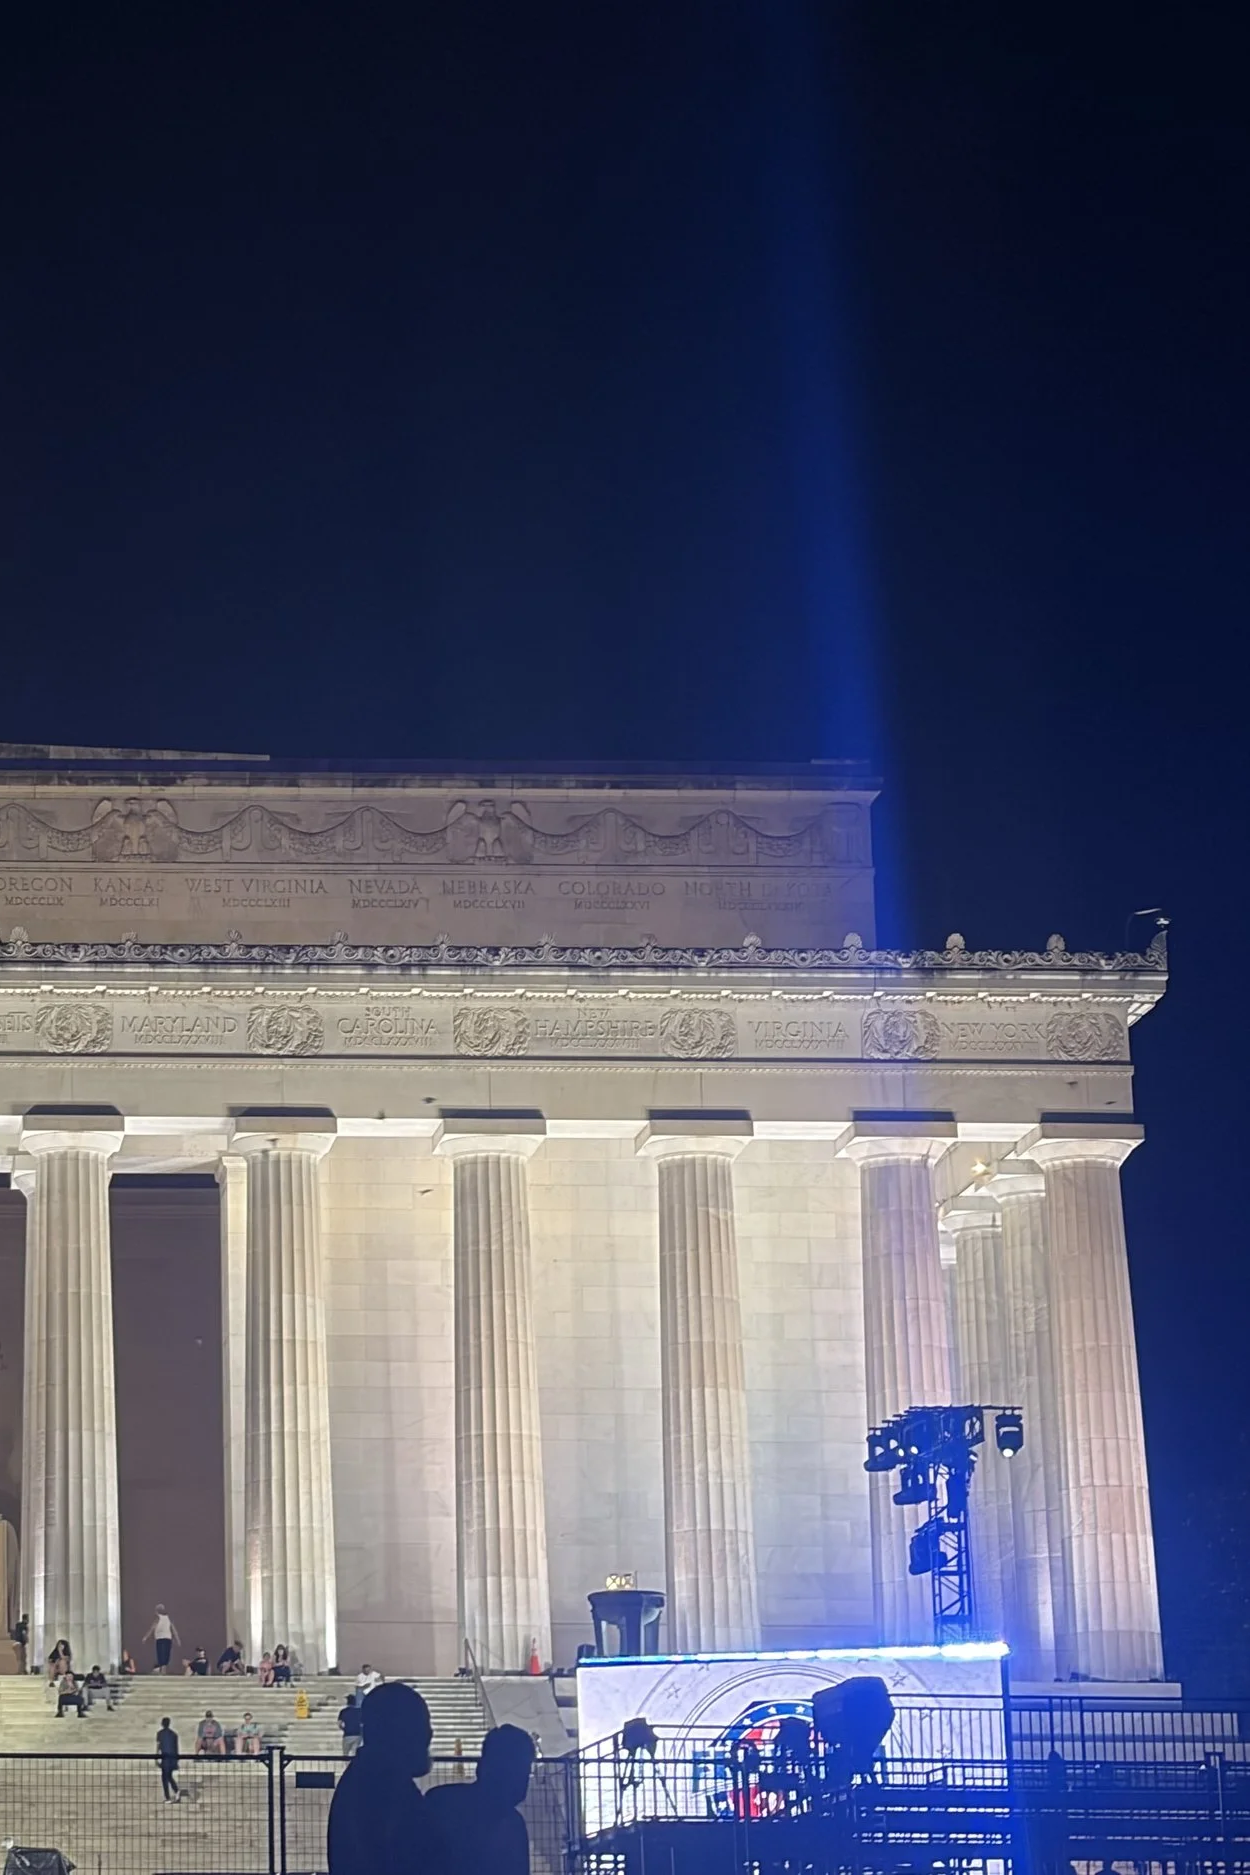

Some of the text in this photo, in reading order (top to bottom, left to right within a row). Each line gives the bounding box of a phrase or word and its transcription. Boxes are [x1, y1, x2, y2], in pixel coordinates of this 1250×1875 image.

[93, 877, 165, 892] KANSAS
[185, 878, 329, 894] WEST VIRGINIA
[347, 878, 422, 893] NEVADA
[441, 879, 537, 895] NEBRASKA
[558, 880, 666, 896] COLORADO
[364, 1006, 412, 1018] SOUTH
[120, 1015, 239, 1033] MARYLAND
[336, 1017, 439, 1035] CAROLINA
[533, 1019, 656, 1037] HAMPSHIRE
[747, 1020, 850, 1039] VIRGINIA
[941, 1021, 1047, 1042] NEW YORK
